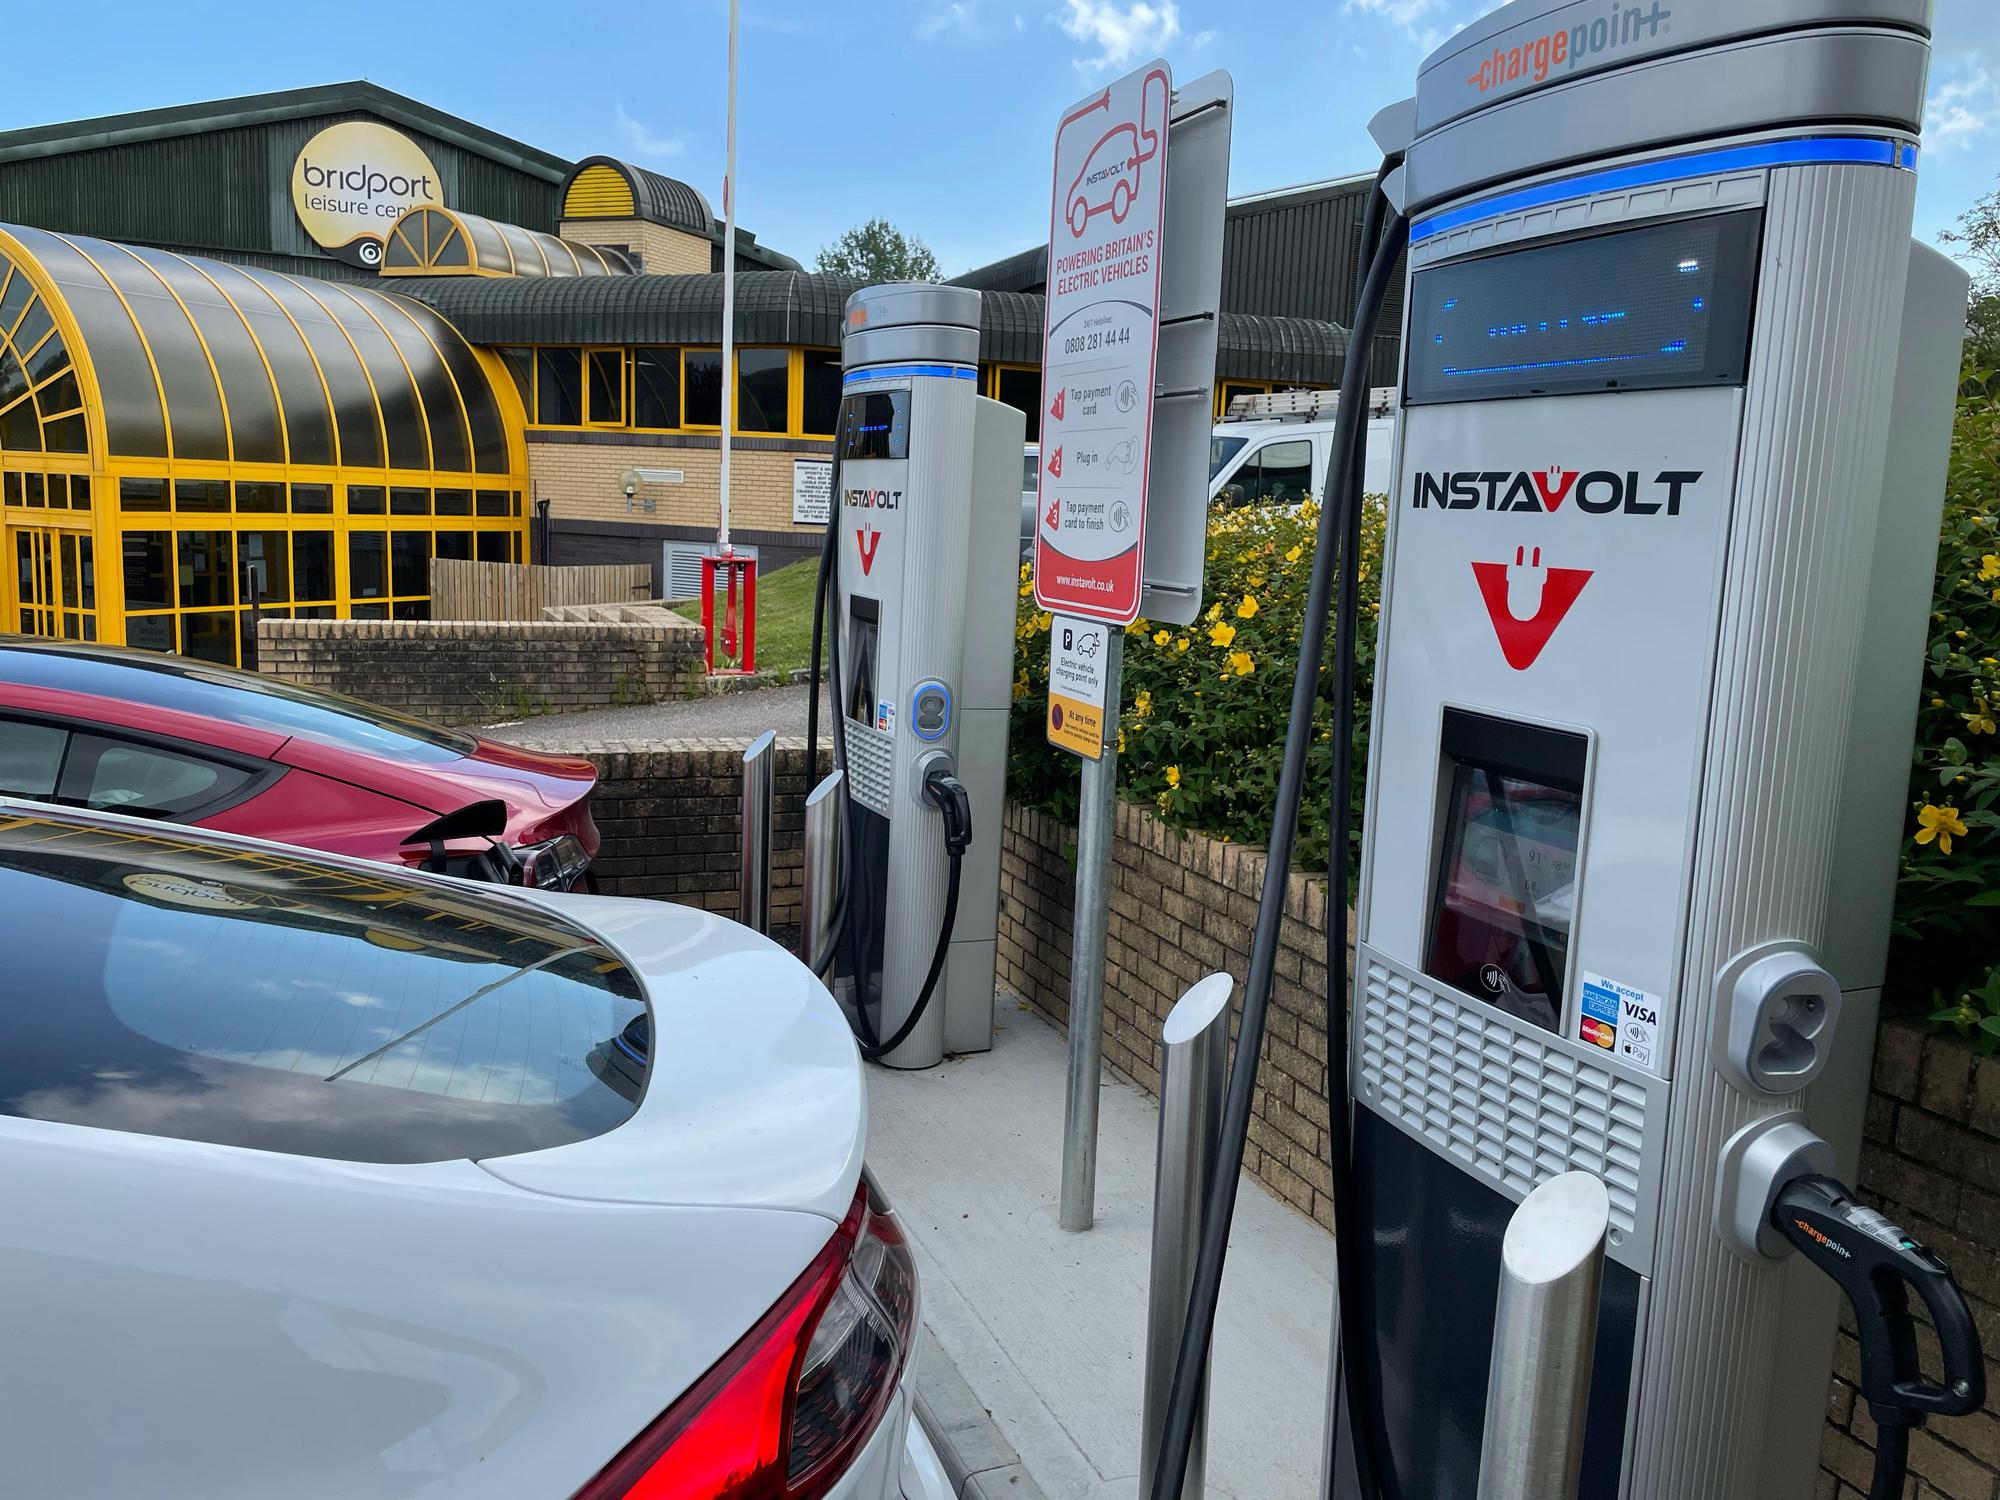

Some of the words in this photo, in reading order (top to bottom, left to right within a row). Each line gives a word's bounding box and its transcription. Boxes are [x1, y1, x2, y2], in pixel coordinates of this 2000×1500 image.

[304, 158, 433, 200] bridport
[1086, 161, 1125, 186] INSTAVOLT
[305, 193, 368, 215] leisure
[375, 203, 413, 218] cen
[1056, 246, 1103, 275] POWERING
[1106, 229, 1154, 260] BRITAIN'S
[1058, 269, 1099, 295] ELECTRIC
[1101, 255, 1149, 283] VEHICLES
[1065, 335, 1085, 354] 0808
[1087, 332, 1102, 350] 281
[1105, 329, 1116, 346] 44
[1118, 326, 1130, 344] 44
[1070, 388, 1082, 402] Tap
[1083, 385, 1112, 401] payment
[1082, 402, 1097, 415] card
[1054, 456, 1060, 471] 2
[1076, 451, 1090, 466] Plug
[1091, 453, 1098, 463] in
[844, 490, 902, 510] INSTAVOLT
[1413, 468, 1704, 516] INSTAVOLT
[1052, 509, 1058, 524] 3
[1066, 501, 1077, 515] Tap
[1077, 503, 1105, 516] payment
[1064, 517, 1078, 529] card
[1078, 518, 1085, 529] to
[1086, 517, 1104, 530] finish
[1056, 575, 1114, 592] www.instavolt.co.uk
[1065, 632, 1071, 647] P
[1060, 656, 1078, 670] Electric
[1078, 661, 1095, 675] vehicle
[1055, 667, 1075, 682] charging
[1075, 672, 1088, 683] point
[1088, 675, 1099, 688] only
[1068, 710, 1075, 720] At
[1075, 713, 1084, 726] any
[1084, 715, 1097, 728] time
[1583, 989, 1617, 1008] AMERICAN
[1600, 978, 1614, 989] We
[1615, 985, 1645, 1002] accept
[1588, 1000, 1618, 1017] EXPRESS
[1623, 1000, 1657, 1026] VISA
[1582, 1025, 1614, 1042] MasterCard
[1632, 1046, 1648, 1062] Pay
